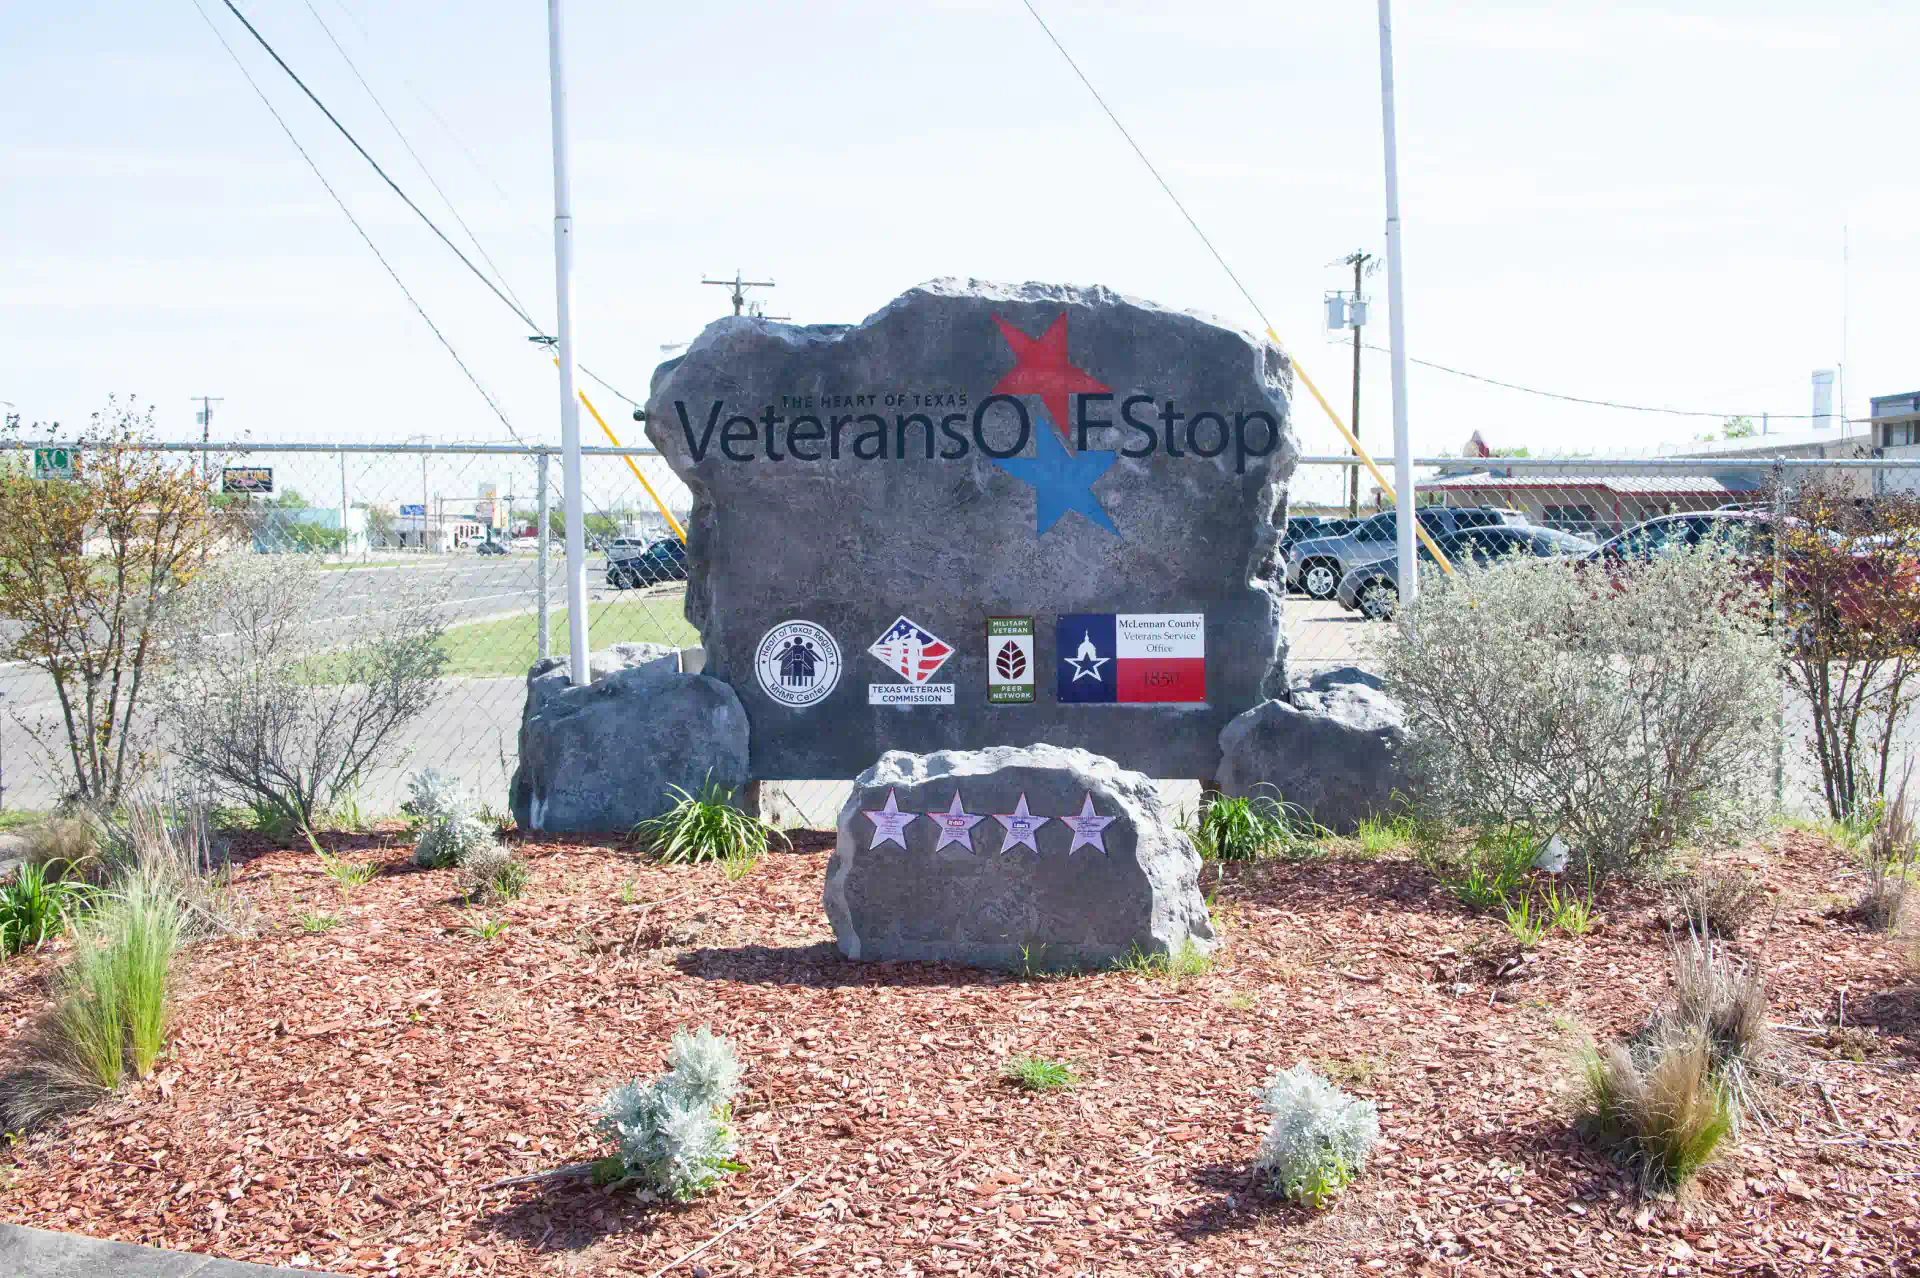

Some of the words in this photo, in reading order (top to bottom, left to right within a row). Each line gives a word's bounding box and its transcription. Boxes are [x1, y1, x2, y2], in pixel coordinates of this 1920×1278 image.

[783, 395, 813, 408] THE
[820, 395, 876, 408] HEART
[884, 394, 906, 406] OF
[913, 394, 968, 406] TEXAS
[1119, 620, 1166, 628] McLennan
[1167, 619, 1200, 630] County
[1124, 631, 1162, 641] Veterans
[1163, 631, 1197, 641] Service
[761, 634, 779, 658] Heart
[778, 628, 788, 638] of
[789, 625, 813, 635] Texas
[813, 630, 835, 659] Region
[1146, 643, 1174, 653] Office
[769, 683, 795, 701] MHMR
[796, 684, 826, 702] Center
[872, 685, 902, 693] TEXAS
[903, 685, 952, 693] VETERANS
[882, 694, 942, 702] COMMISSION
